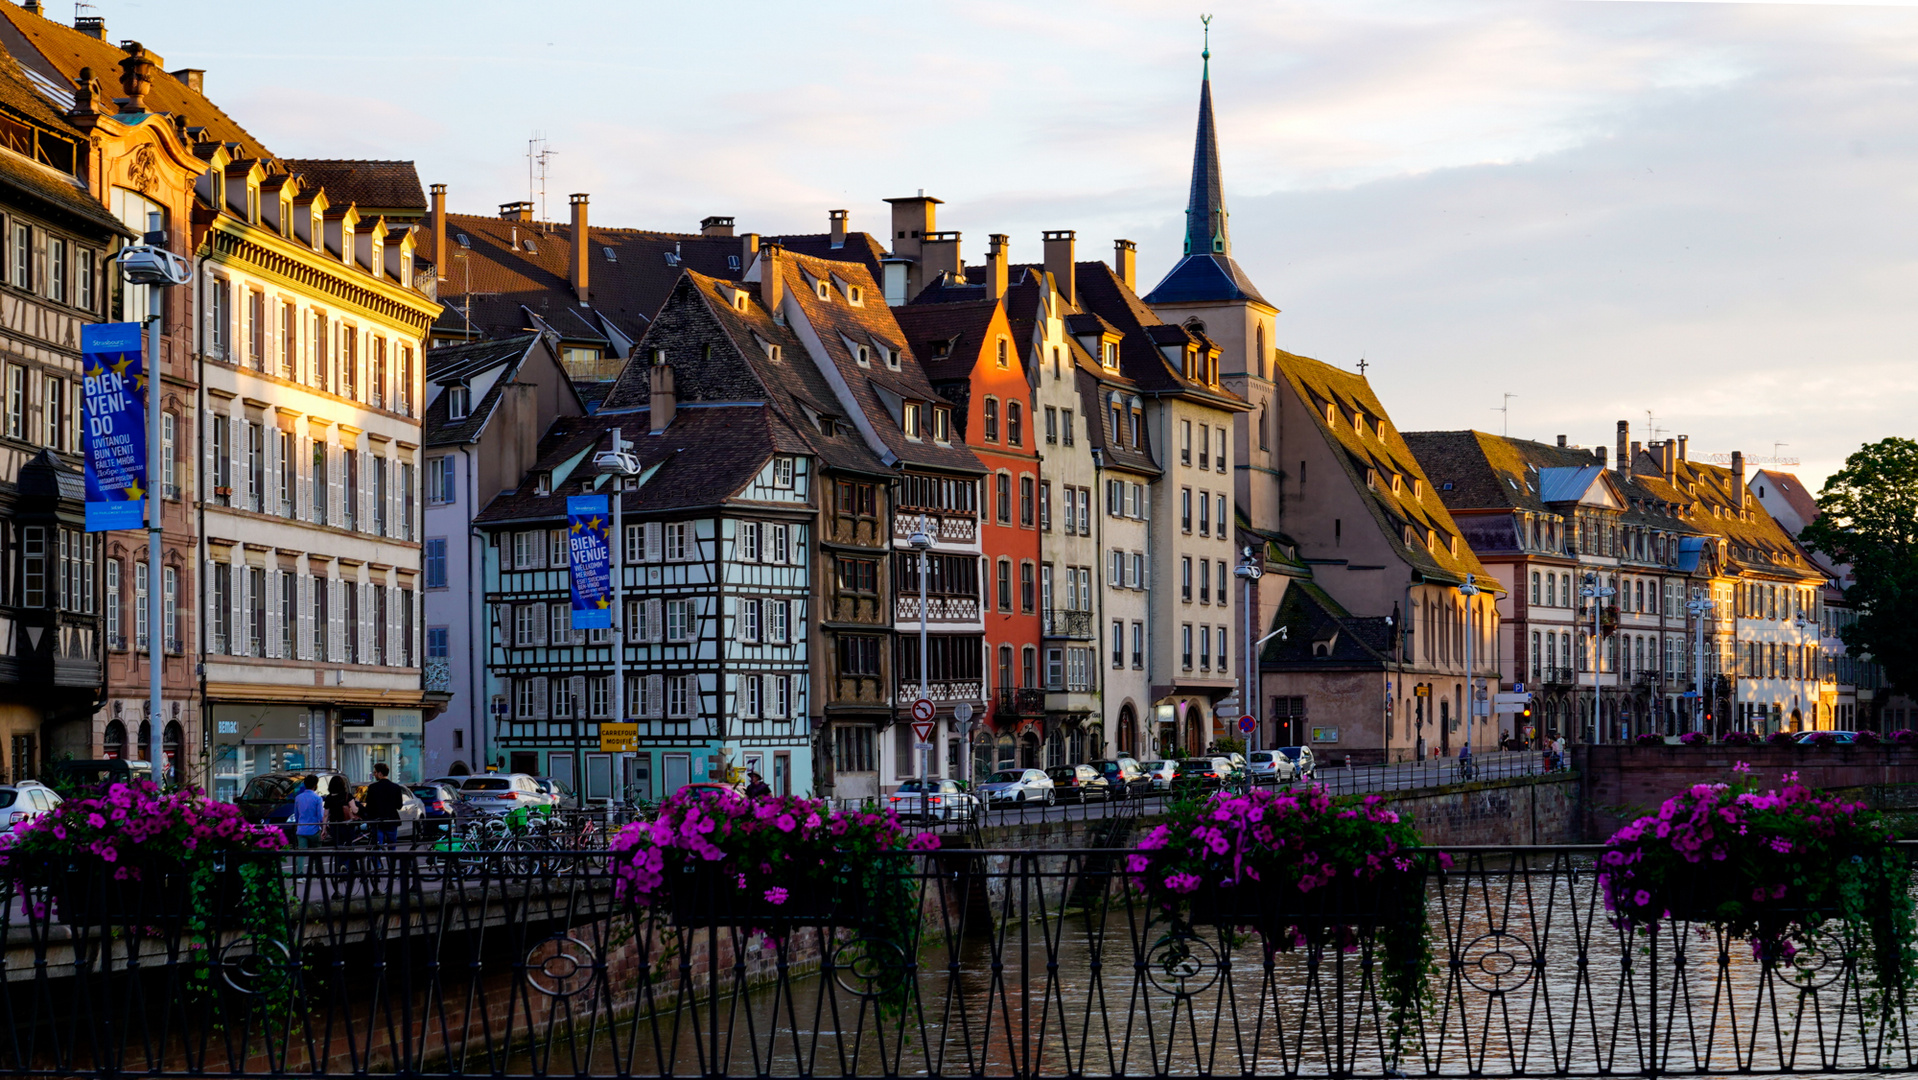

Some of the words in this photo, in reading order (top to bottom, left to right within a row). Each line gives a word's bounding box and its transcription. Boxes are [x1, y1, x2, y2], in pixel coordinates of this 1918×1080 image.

[84, 371, 130, 396] BIEN-
[86, 392, 132, 416] VENI-
[90, 415, 113, 437] DO
[94, 448, 111, 460] BUN
[111, 444, 134, 457] VENIT
[570, 535, 601, 551] BIEN-
[572, 546, 608, 564] VENUE
[1515, 684, 1522, 692] P
